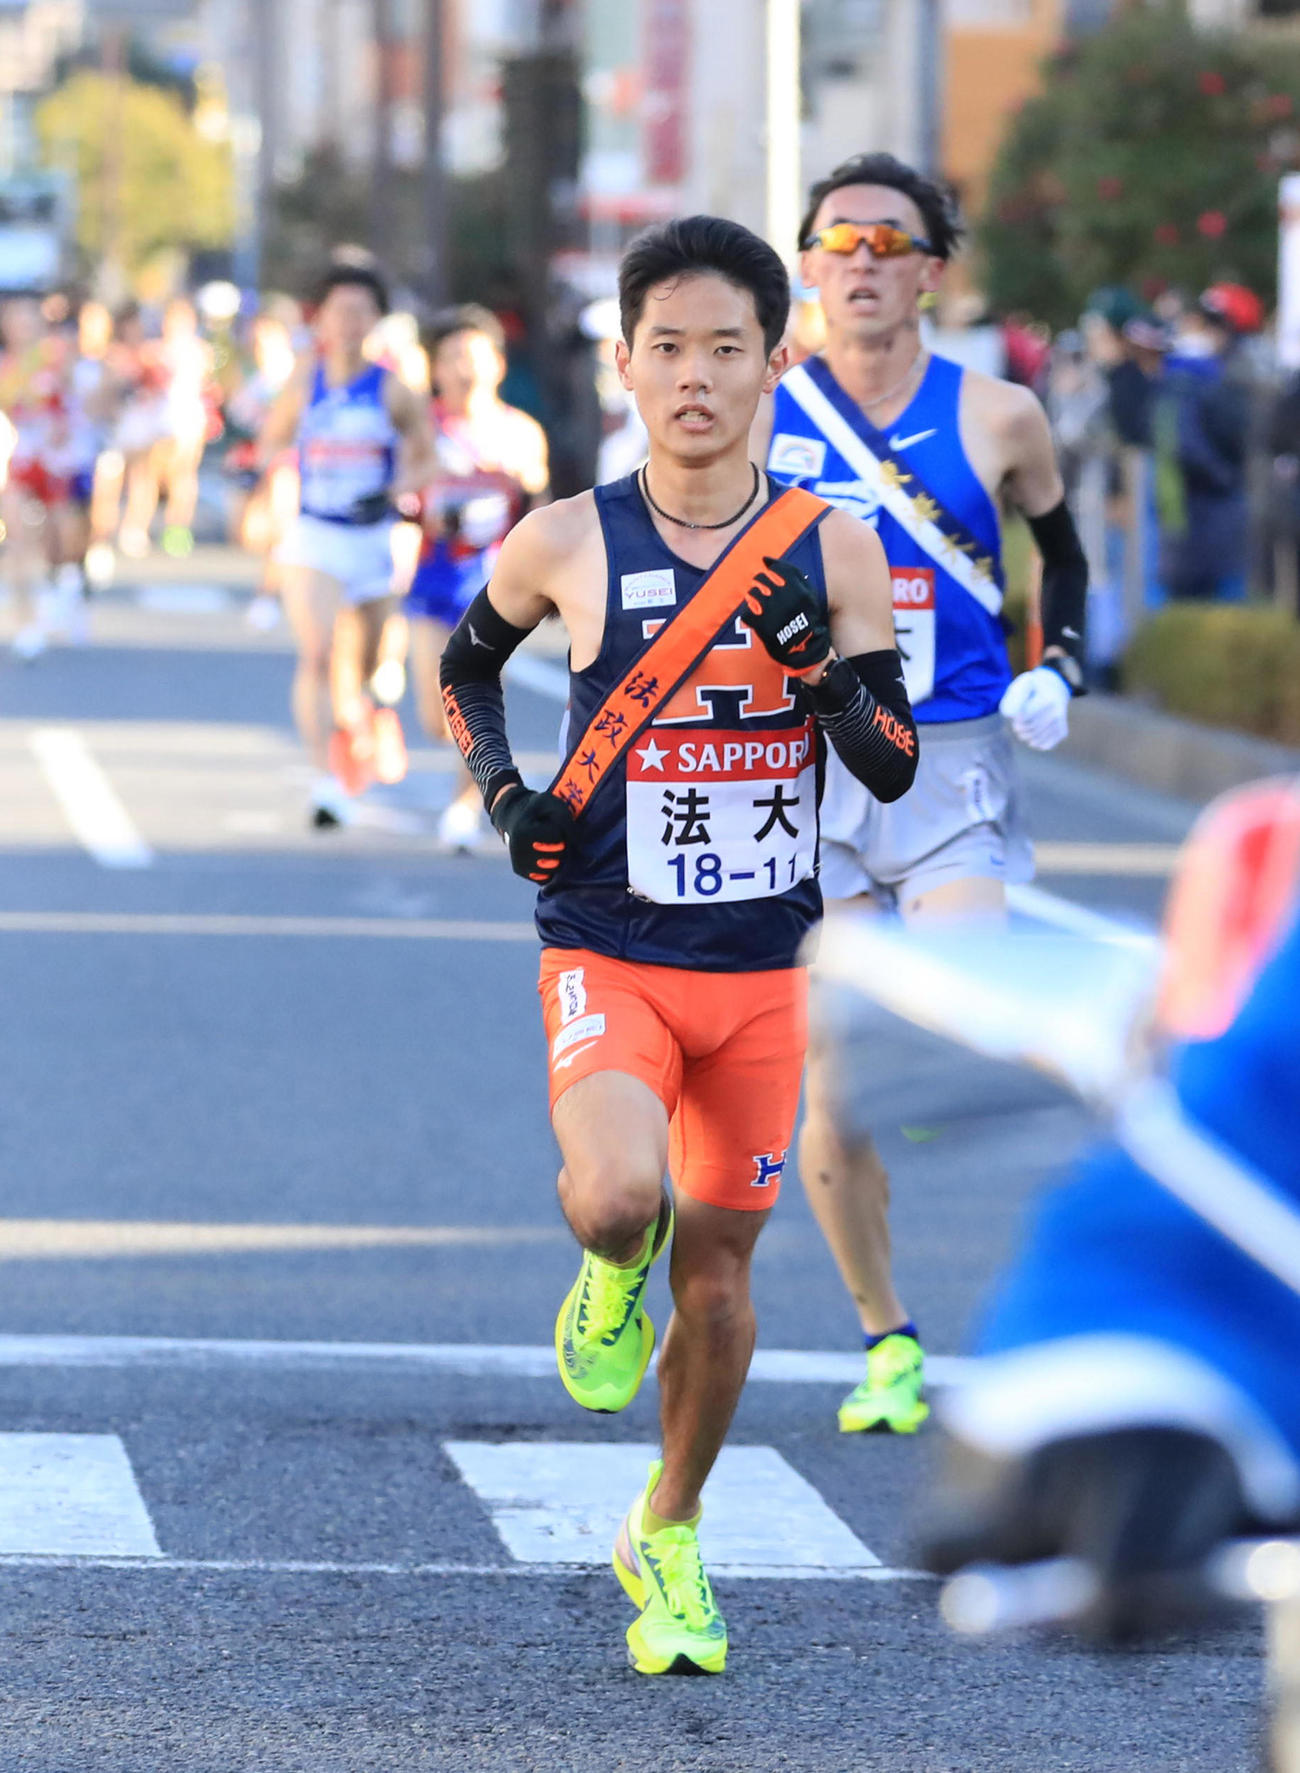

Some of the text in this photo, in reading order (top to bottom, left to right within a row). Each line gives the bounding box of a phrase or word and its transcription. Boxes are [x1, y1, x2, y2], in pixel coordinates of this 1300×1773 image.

[776, 612, 809, 646] HOSEI
[872, 704, 915, 757] HOSE
[666, 852, 797, 897] 18-11
